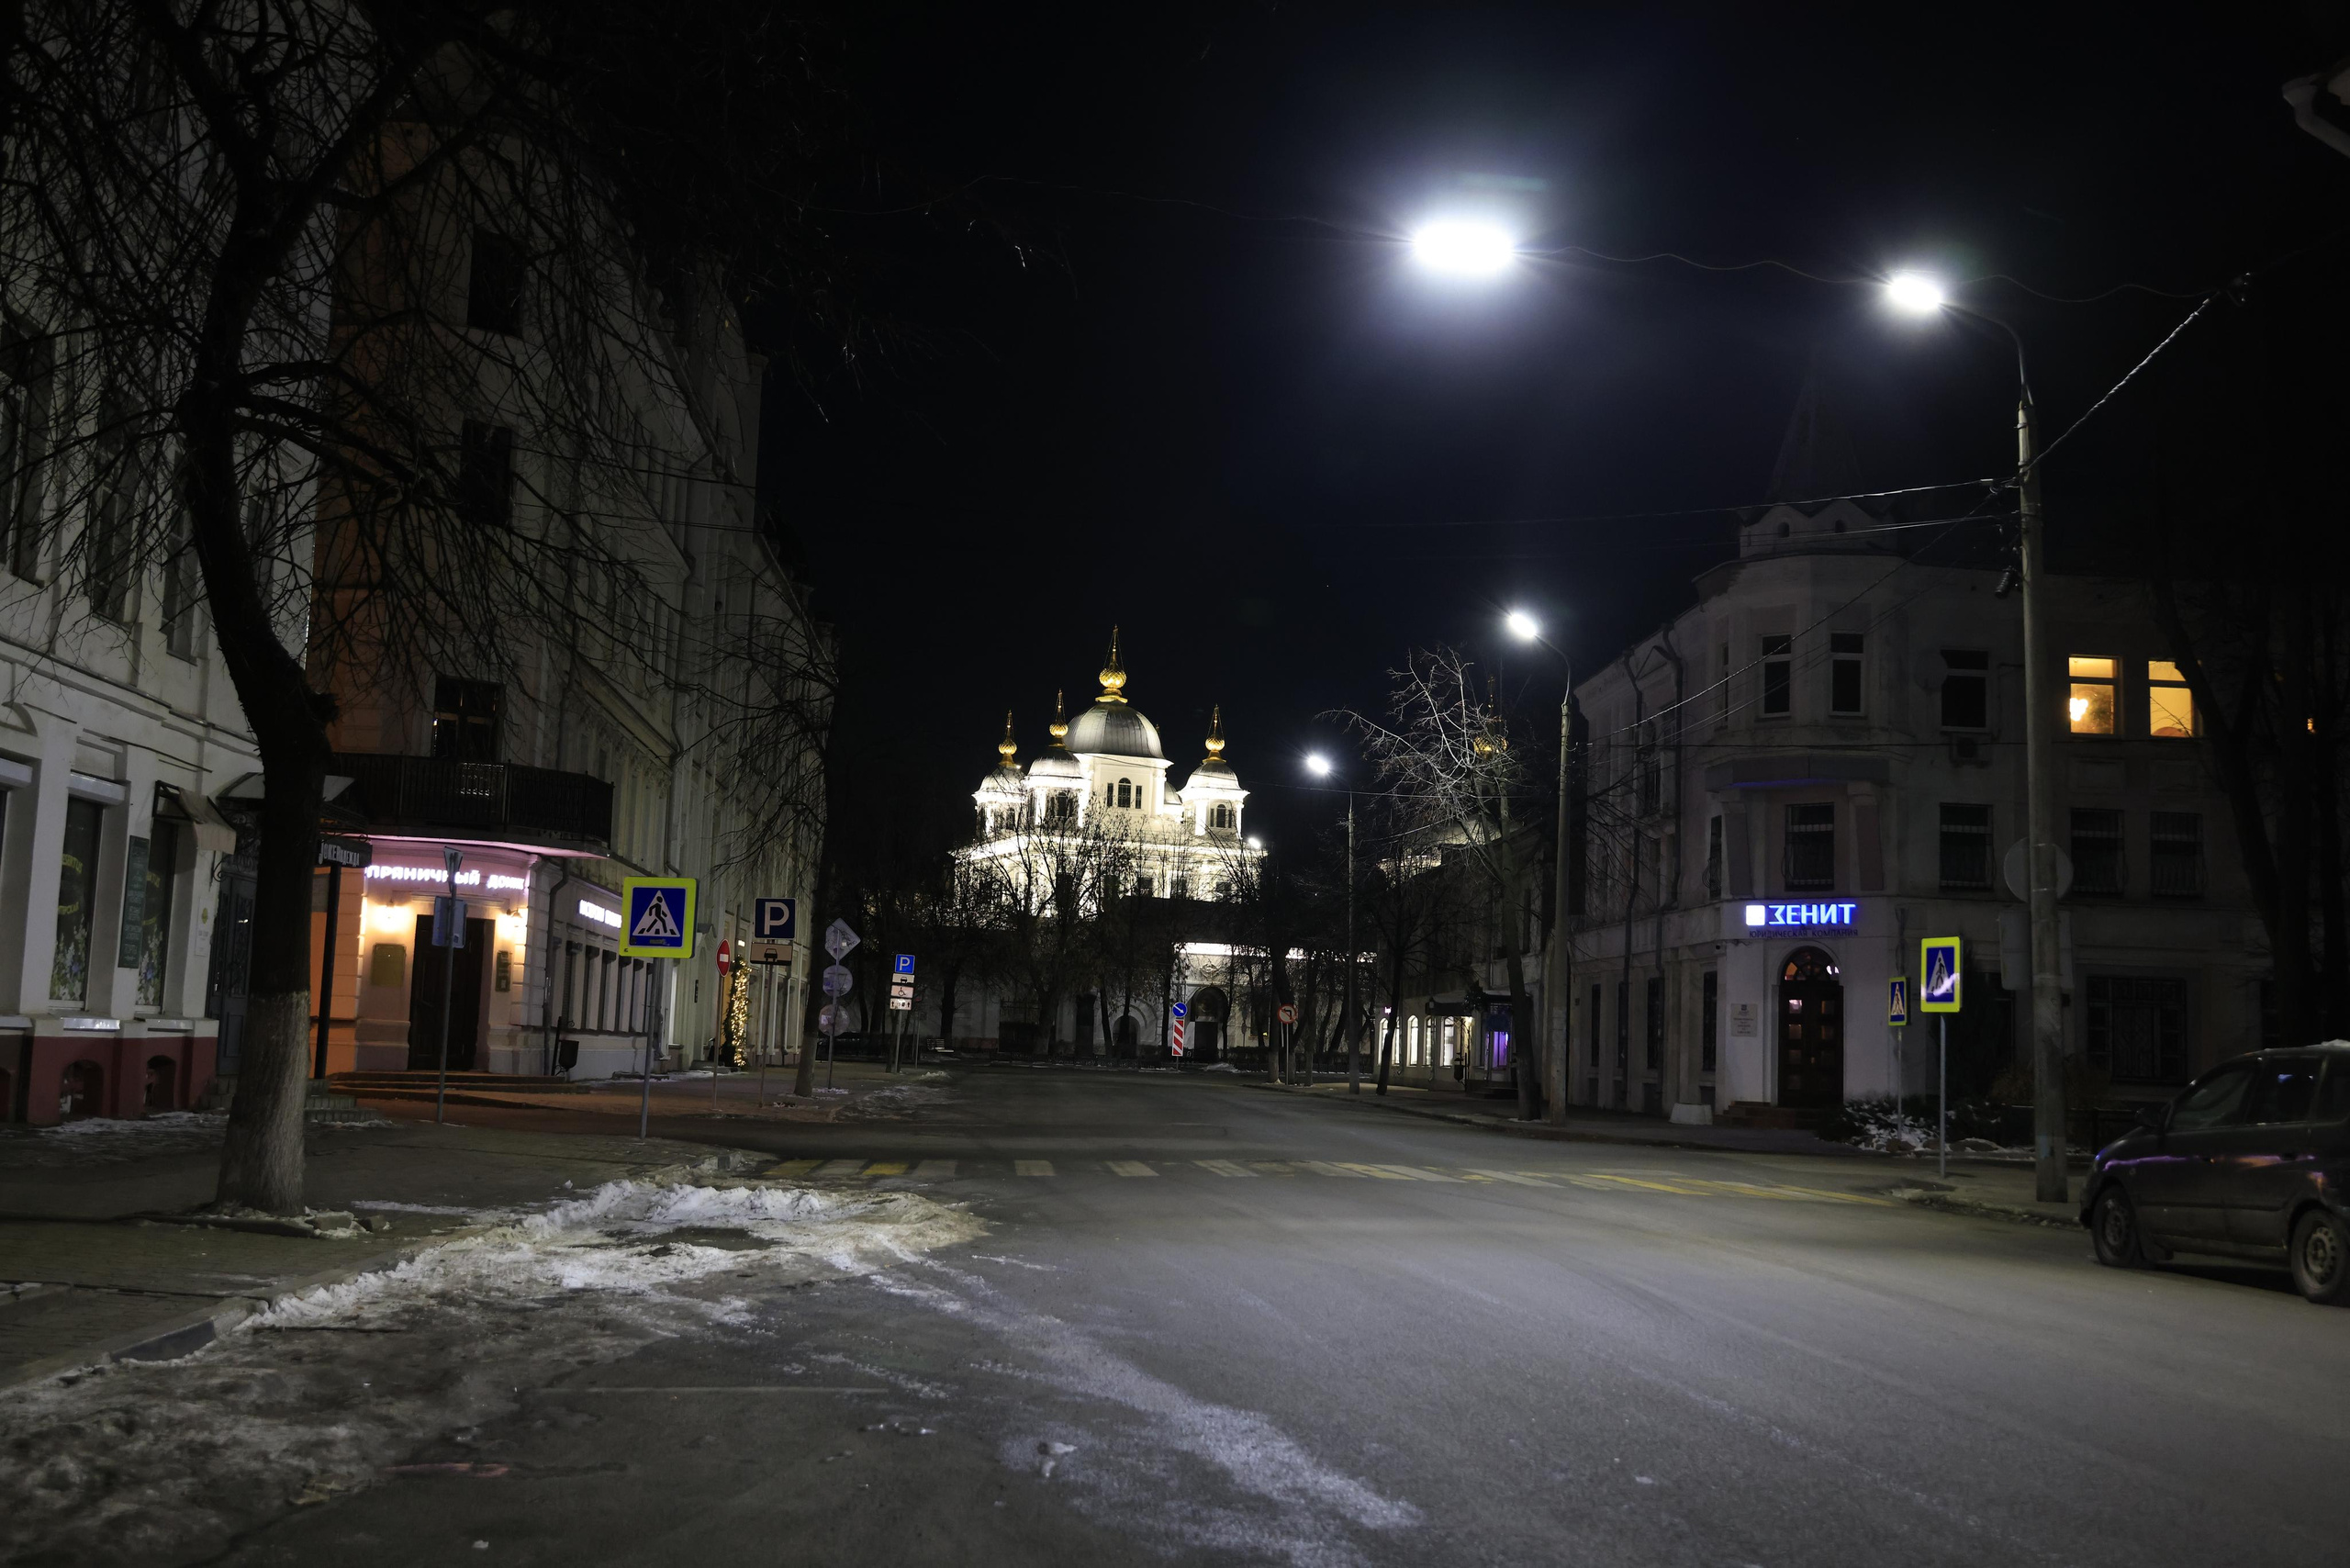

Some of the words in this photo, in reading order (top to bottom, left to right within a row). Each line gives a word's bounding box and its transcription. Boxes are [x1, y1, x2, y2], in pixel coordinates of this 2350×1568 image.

[319, 839, 341, 864] JOKER
[764, 902, 789, 935] P
[1769, 903, 1856, 924] ЗЕНИТ
[1749, 929, 1807, 939] ЮРИДИЧЕСКАЯ
[1812, 928, 1858, 937] КОМПАНИЯ
[900, 957, 911, 970] P
